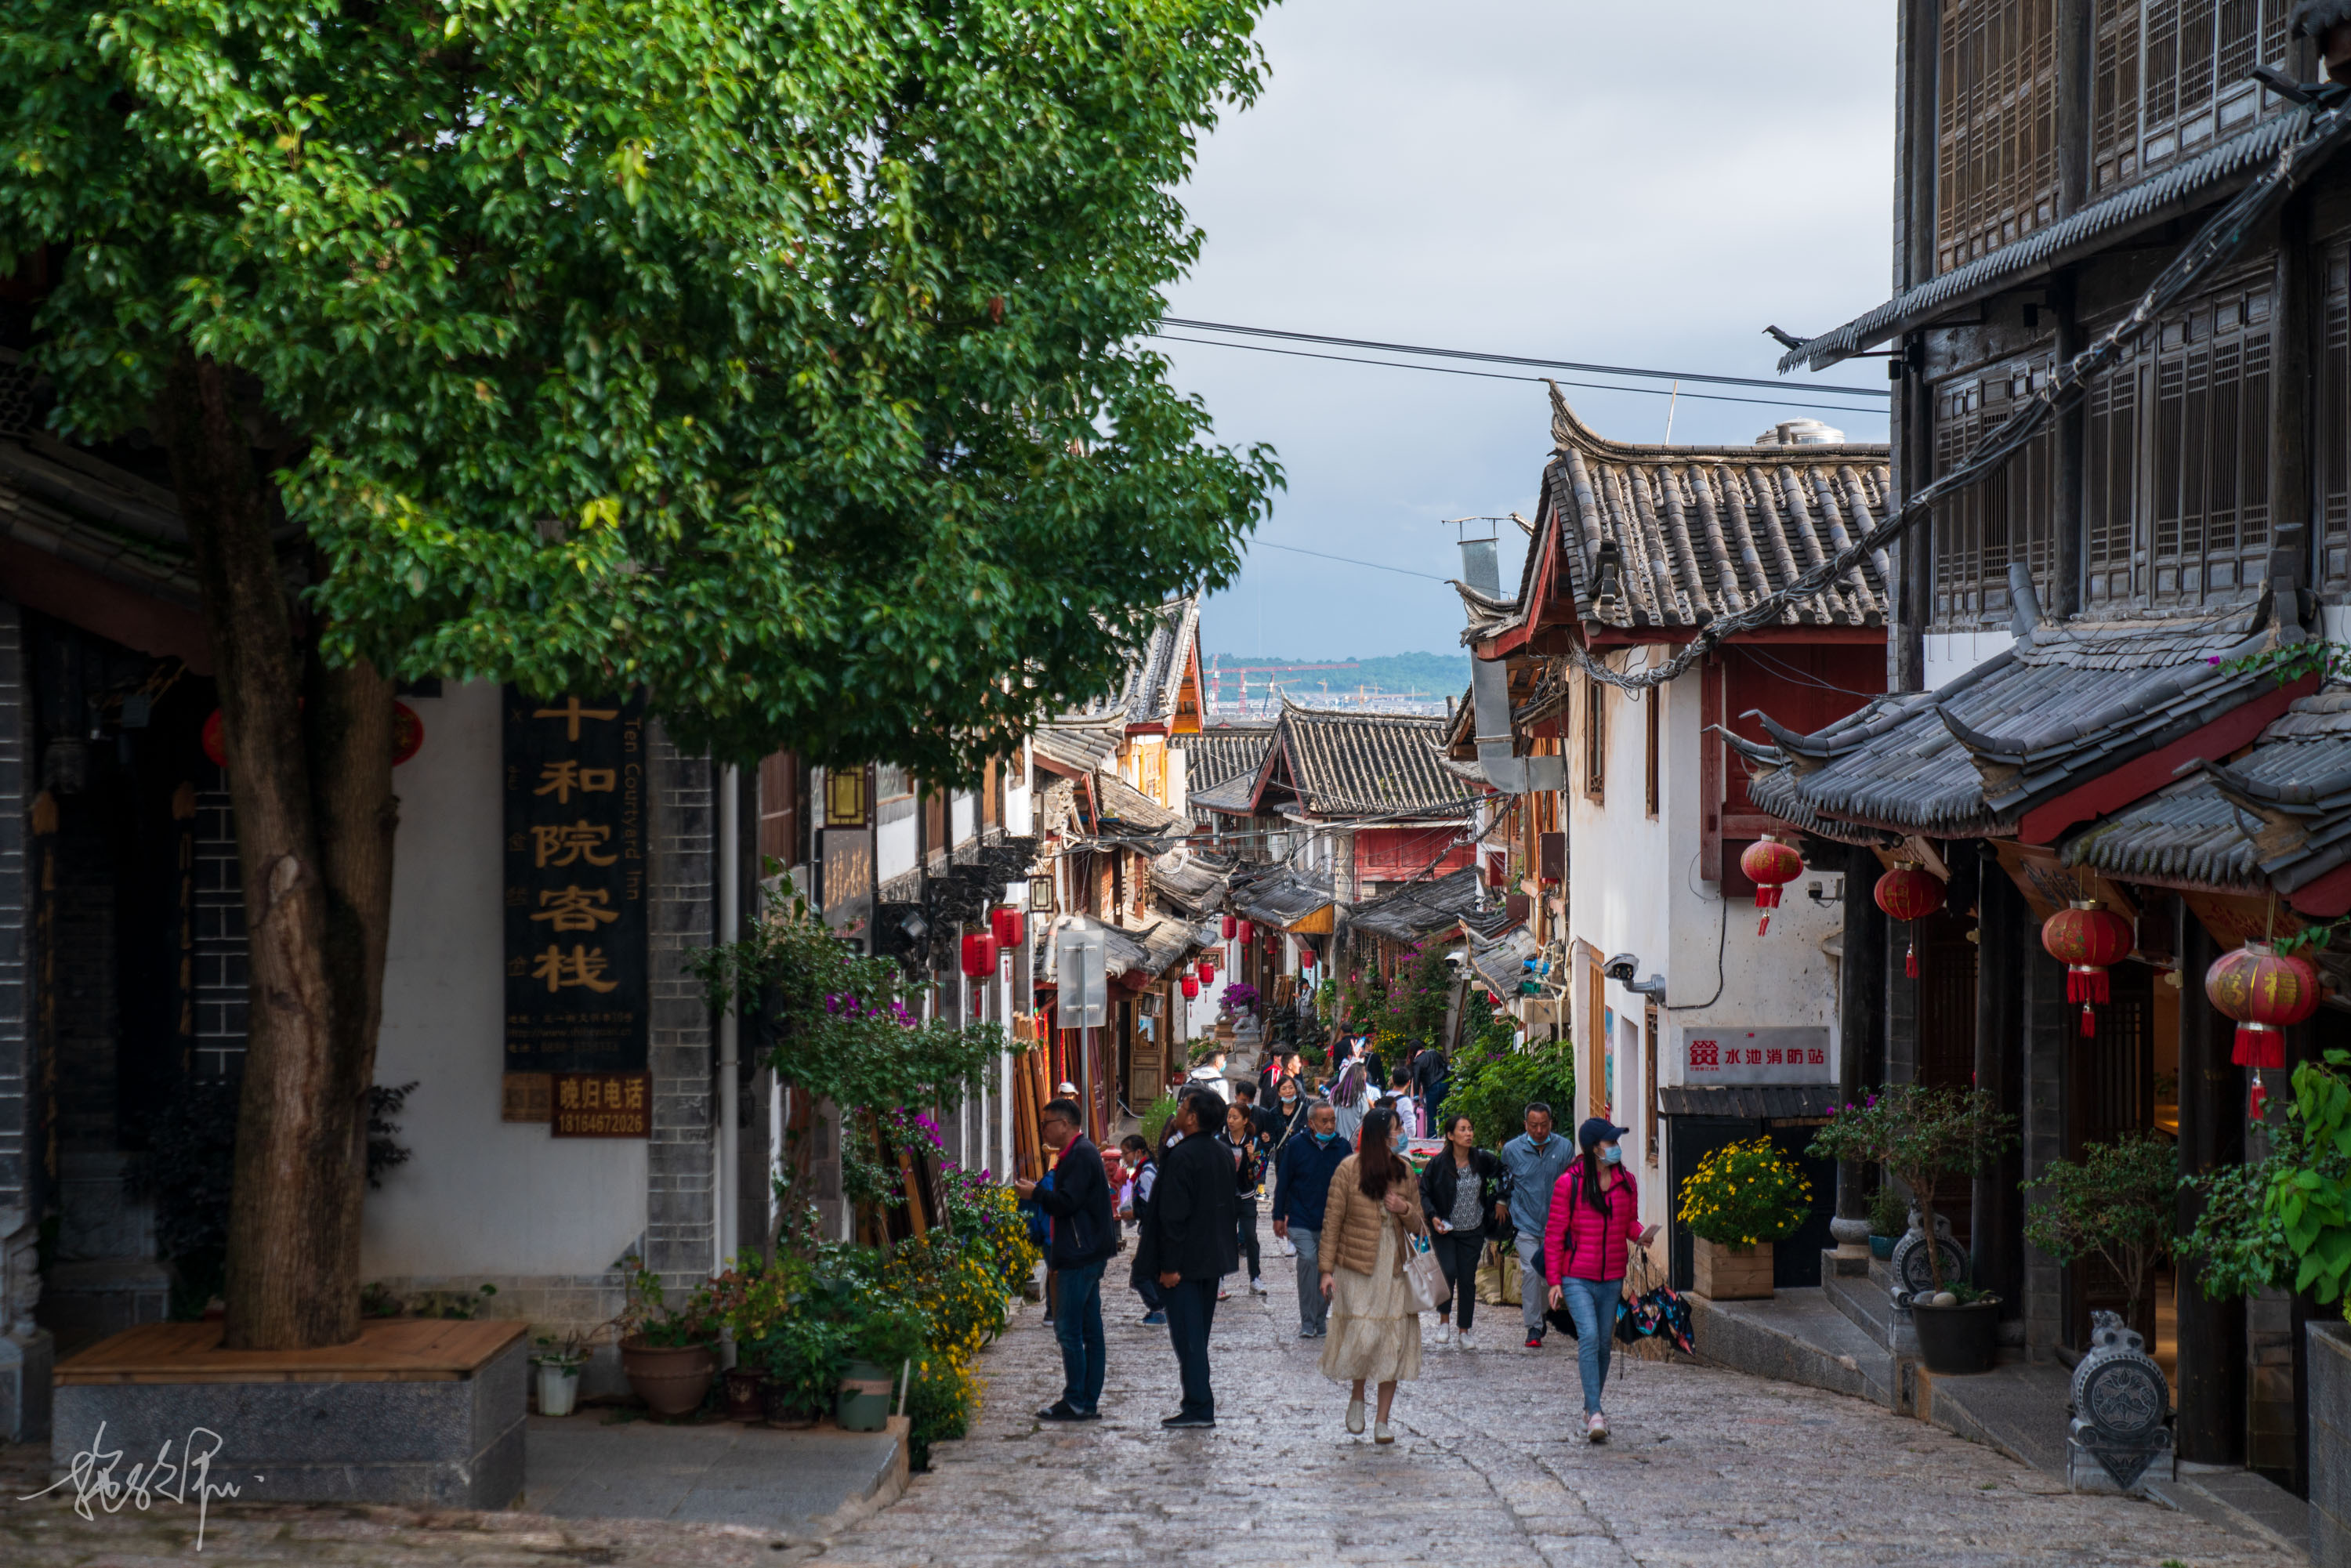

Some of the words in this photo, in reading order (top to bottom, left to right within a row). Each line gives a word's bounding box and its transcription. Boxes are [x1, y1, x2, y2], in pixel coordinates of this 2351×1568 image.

[624, 716, 643, 752] Ten
[621, 762, 643, 860] Courtyard
[530, 696, 620, 994] 十和院客栈
[626, 871, 643, 901] Inn
[2263, 972, 2301, 1005] 福
[1725, 1048, 1824, 1065] 水池消防站
[559, 1077, 644, 1110] 晚归电话
[558, 1114, 644, 1133] 18164672026
